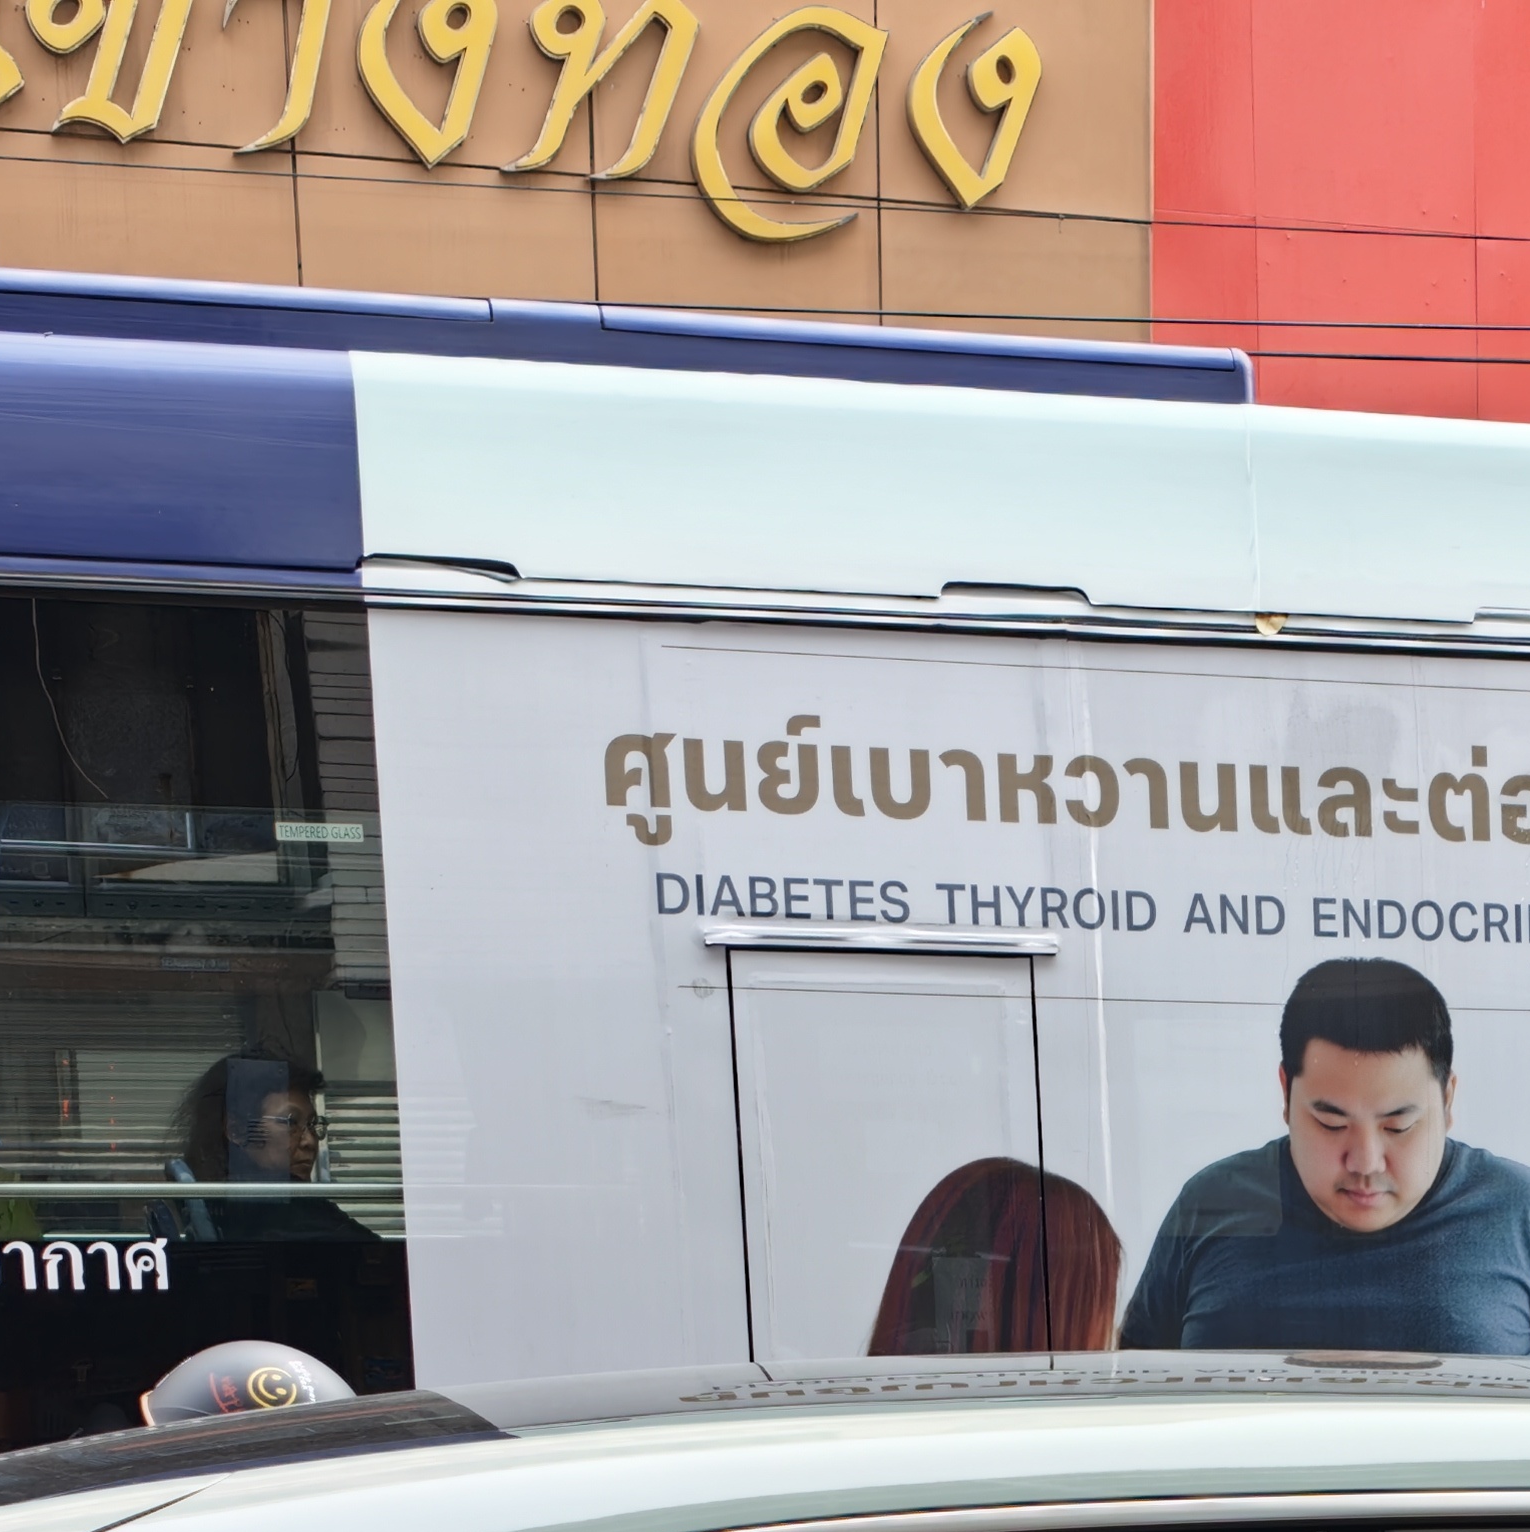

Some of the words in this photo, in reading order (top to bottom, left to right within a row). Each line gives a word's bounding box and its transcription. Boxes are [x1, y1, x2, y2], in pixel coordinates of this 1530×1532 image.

[279, 824, 327, 839] TEMPERED
[332, 826, 361, 841] GLASS
[656, 872, 910, 925] DIABETES
[938, 881, 1158, 933] THYROID
[1183, 891, 1285, 936] AND
